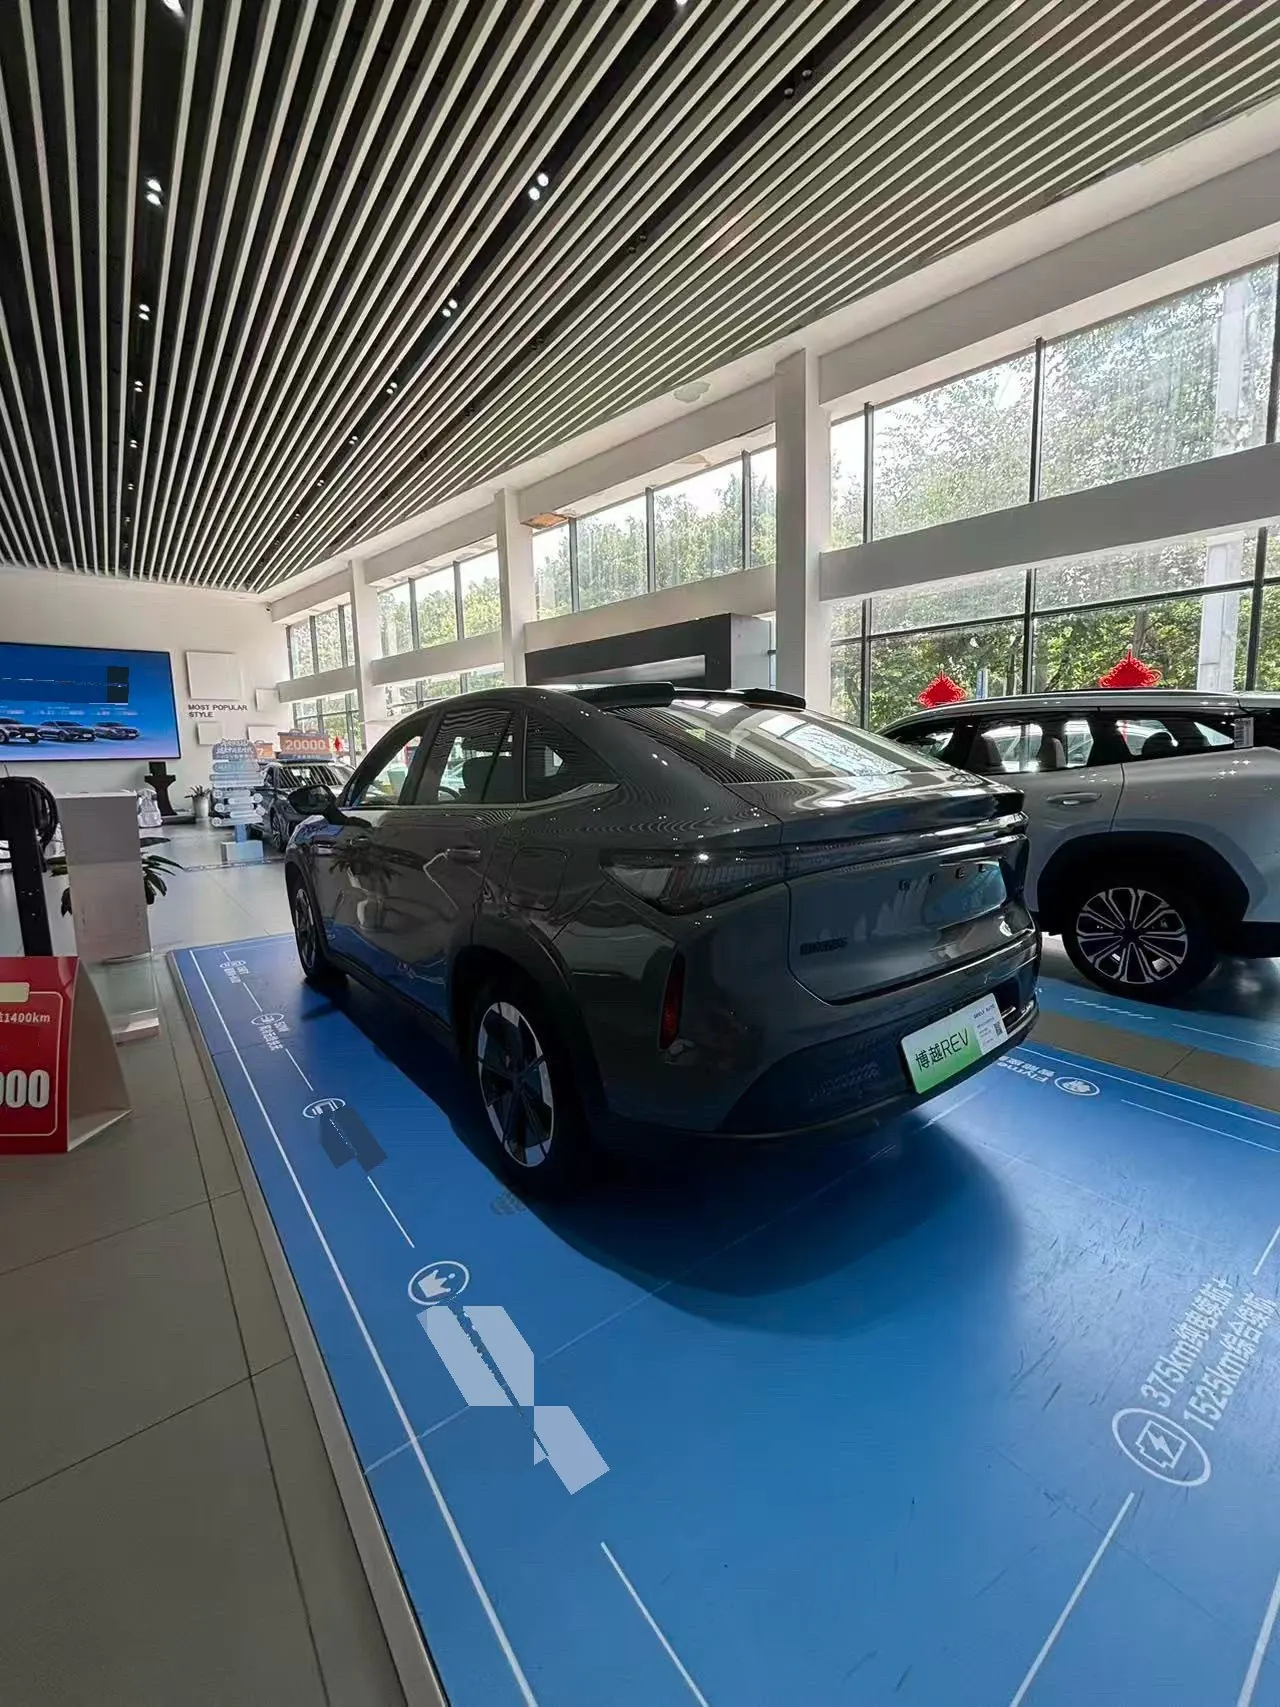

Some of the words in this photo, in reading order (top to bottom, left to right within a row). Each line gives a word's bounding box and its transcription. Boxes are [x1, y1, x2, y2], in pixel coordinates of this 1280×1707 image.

[285, 739, 326, 751] 20000
[914, 1026, 970, 1073] 博越REV
[0, 1069, 50, 1109] 00
